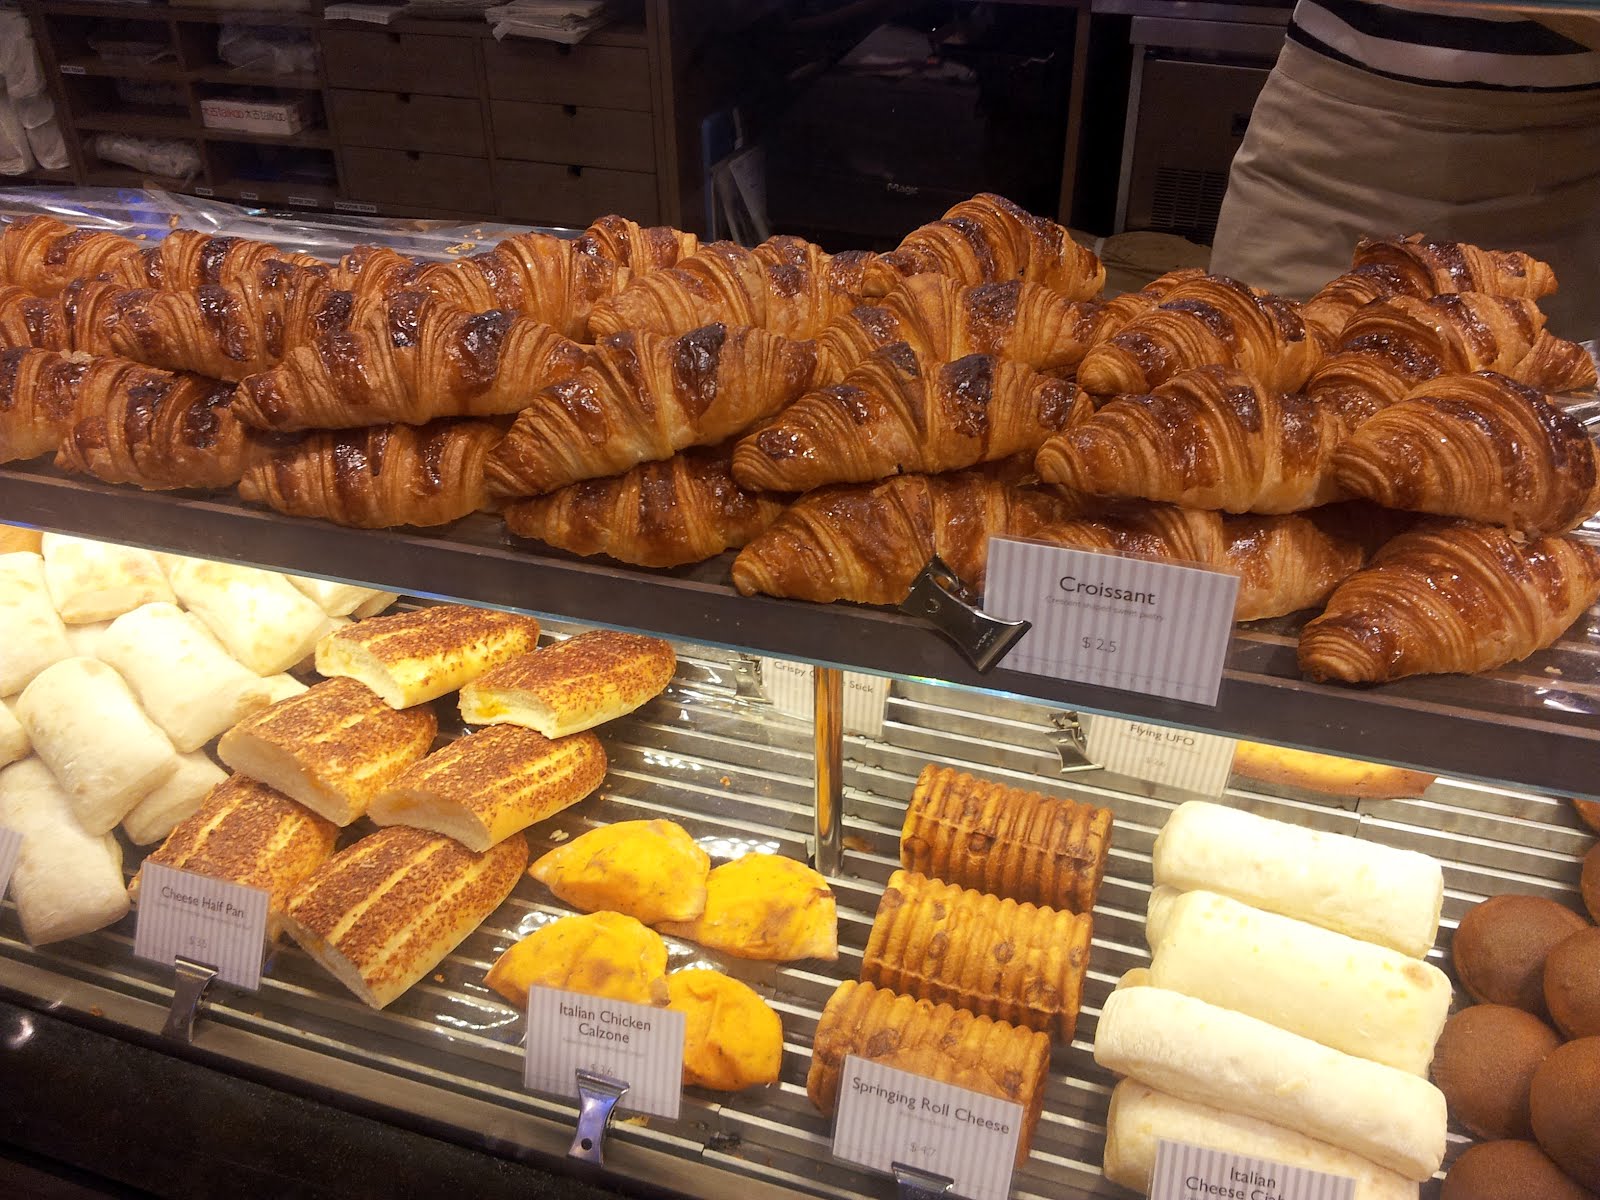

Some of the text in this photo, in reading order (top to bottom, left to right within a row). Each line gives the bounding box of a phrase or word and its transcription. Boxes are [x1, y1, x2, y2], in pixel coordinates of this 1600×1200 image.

[1059, 576, 1156, 605] Croissant
[774, 661, 806, 678] Crispy
[850, 680, 874, 694] Stick
[1129, 724, 1161, 741] Flying
[1166, 733, 1195, 746] UFO
[161, 886, 199, 906] Cheese
[202, 896, 224, 913] Half
[226, 903, 245, 918] Pan
[559, 1002, 651, 1032] Italian Chicken
[578, 1022, 630, 1044] Calzone
[852, 1076, 916, 1110] Springing
[921, 1097, 950, 1117] Roll
[955, 1107, 1010, 1135] Cheese
[1185, 1176, 1245, 1200] Cheese
[1230, 1166, 1276, 1189] Italian
